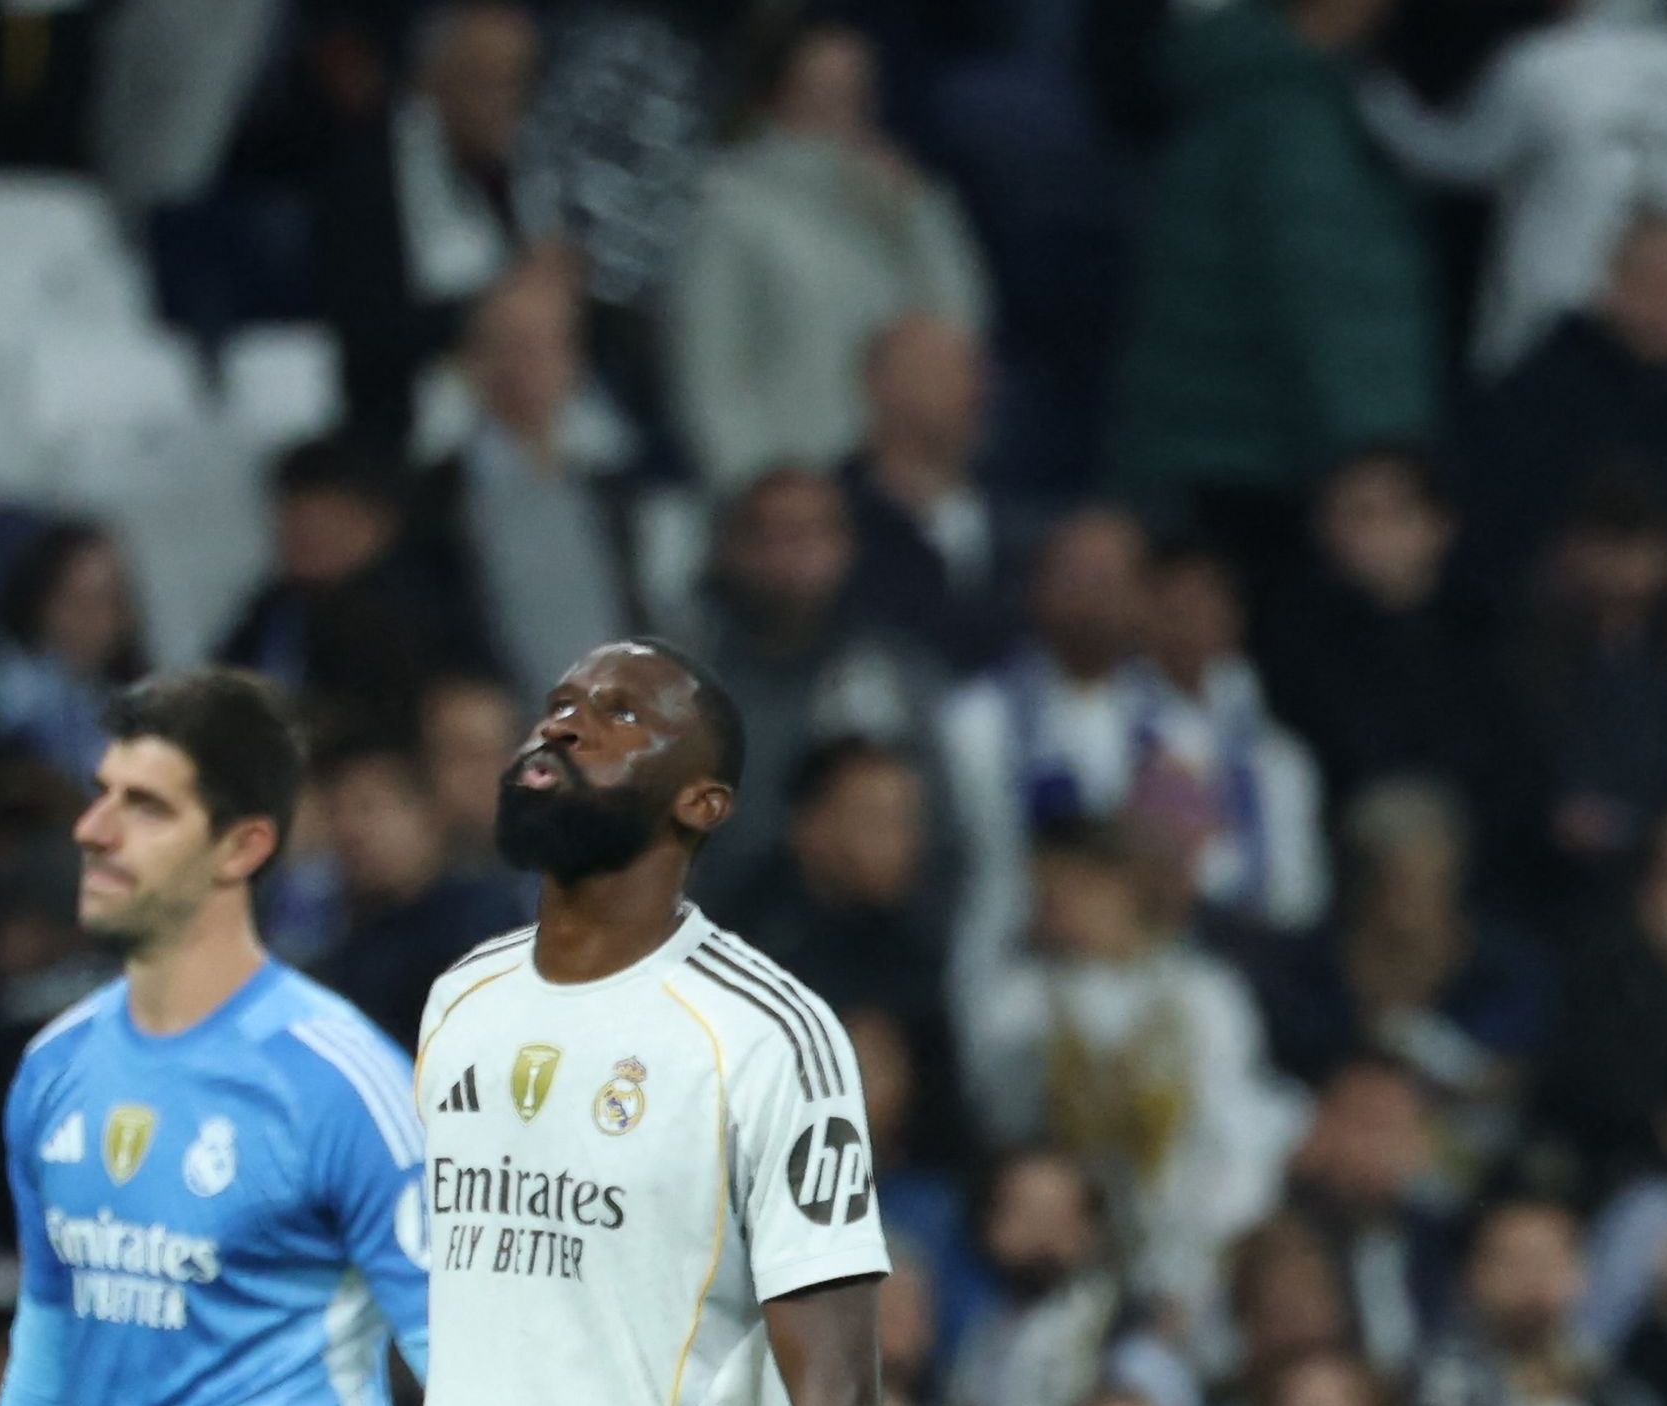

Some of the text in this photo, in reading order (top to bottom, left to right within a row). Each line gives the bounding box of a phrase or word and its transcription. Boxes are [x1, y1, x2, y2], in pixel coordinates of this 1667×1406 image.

[434, 1155, 626, 1230] Emirates
[798, 1117, 865, 1226] hp
[445, 1225, 583, 1281] FLY BETTER
